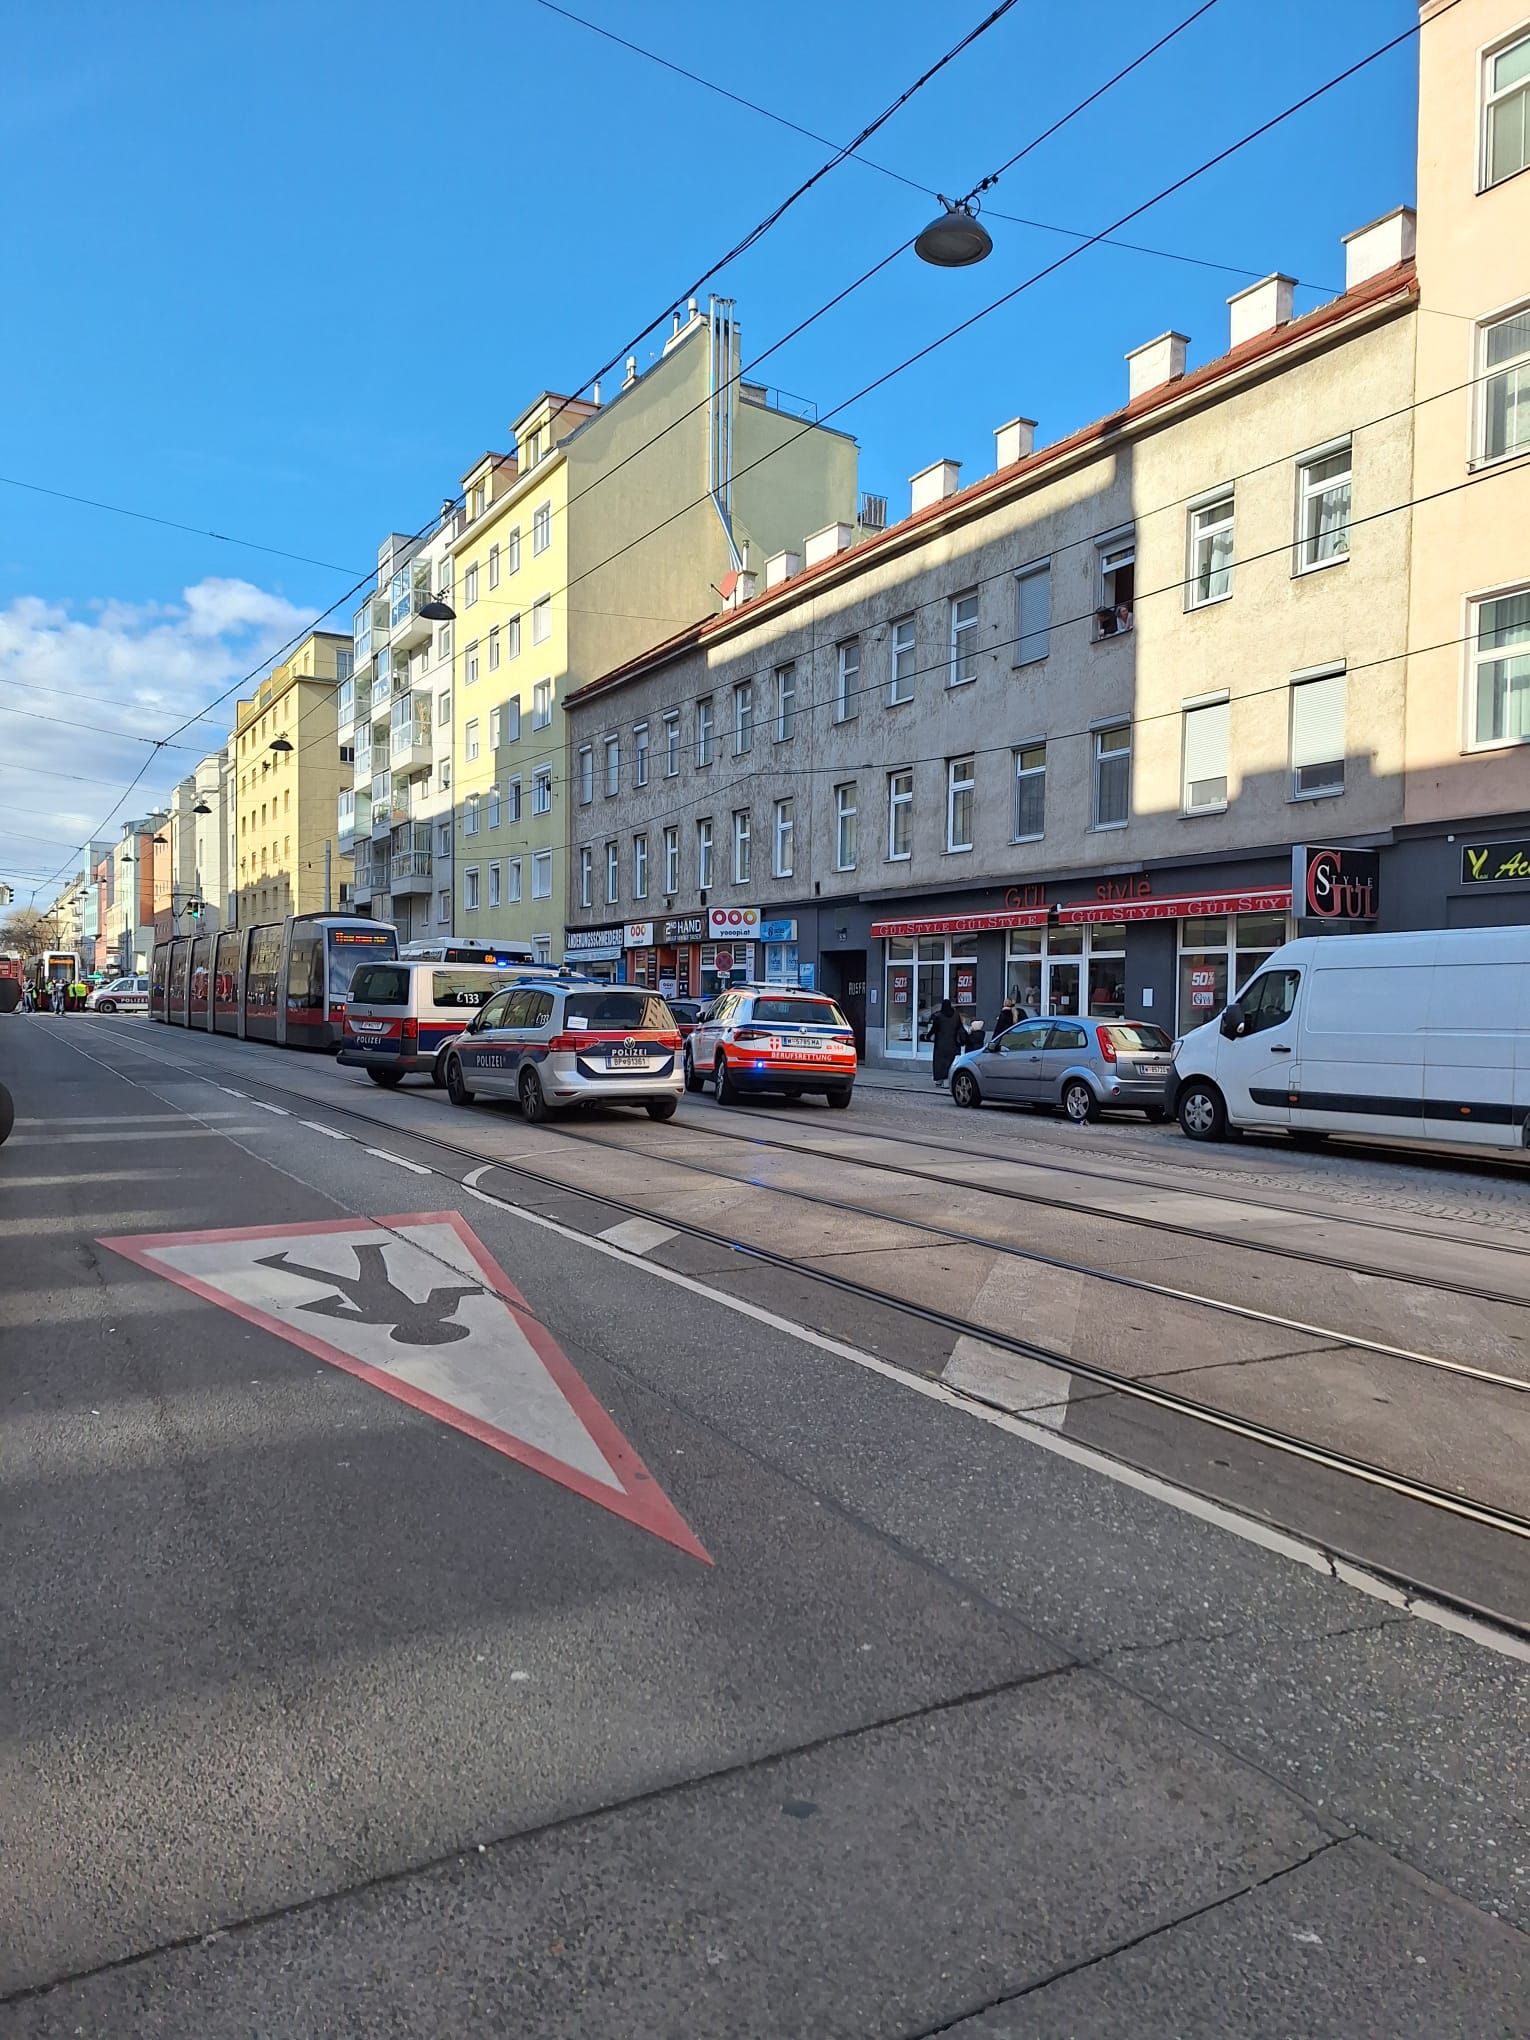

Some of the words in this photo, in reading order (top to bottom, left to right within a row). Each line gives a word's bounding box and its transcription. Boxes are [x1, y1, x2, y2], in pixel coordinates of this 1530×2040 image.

[1494, 851, 1530, 879] Ac
[1317, 864, 1373, 896] STYLE
[1096, 875, 1151, 900] style
[1112, 906, 1178, 920] STYLE
[677, 919, 701, 934] HAND
[988, 915, 1038, 928] STYLE
[1191, 971, 1215, 986] 50%
[463, 993, 480, 1004] 133
[356, 1036, 381, 1045] POLIZEI
[611, 1049, 648, 1057] POLIZEI
[771, 1051, 833, 1062] BERUFSRETTUNG
[476, 1055, 503, 1068] POLIZEI
